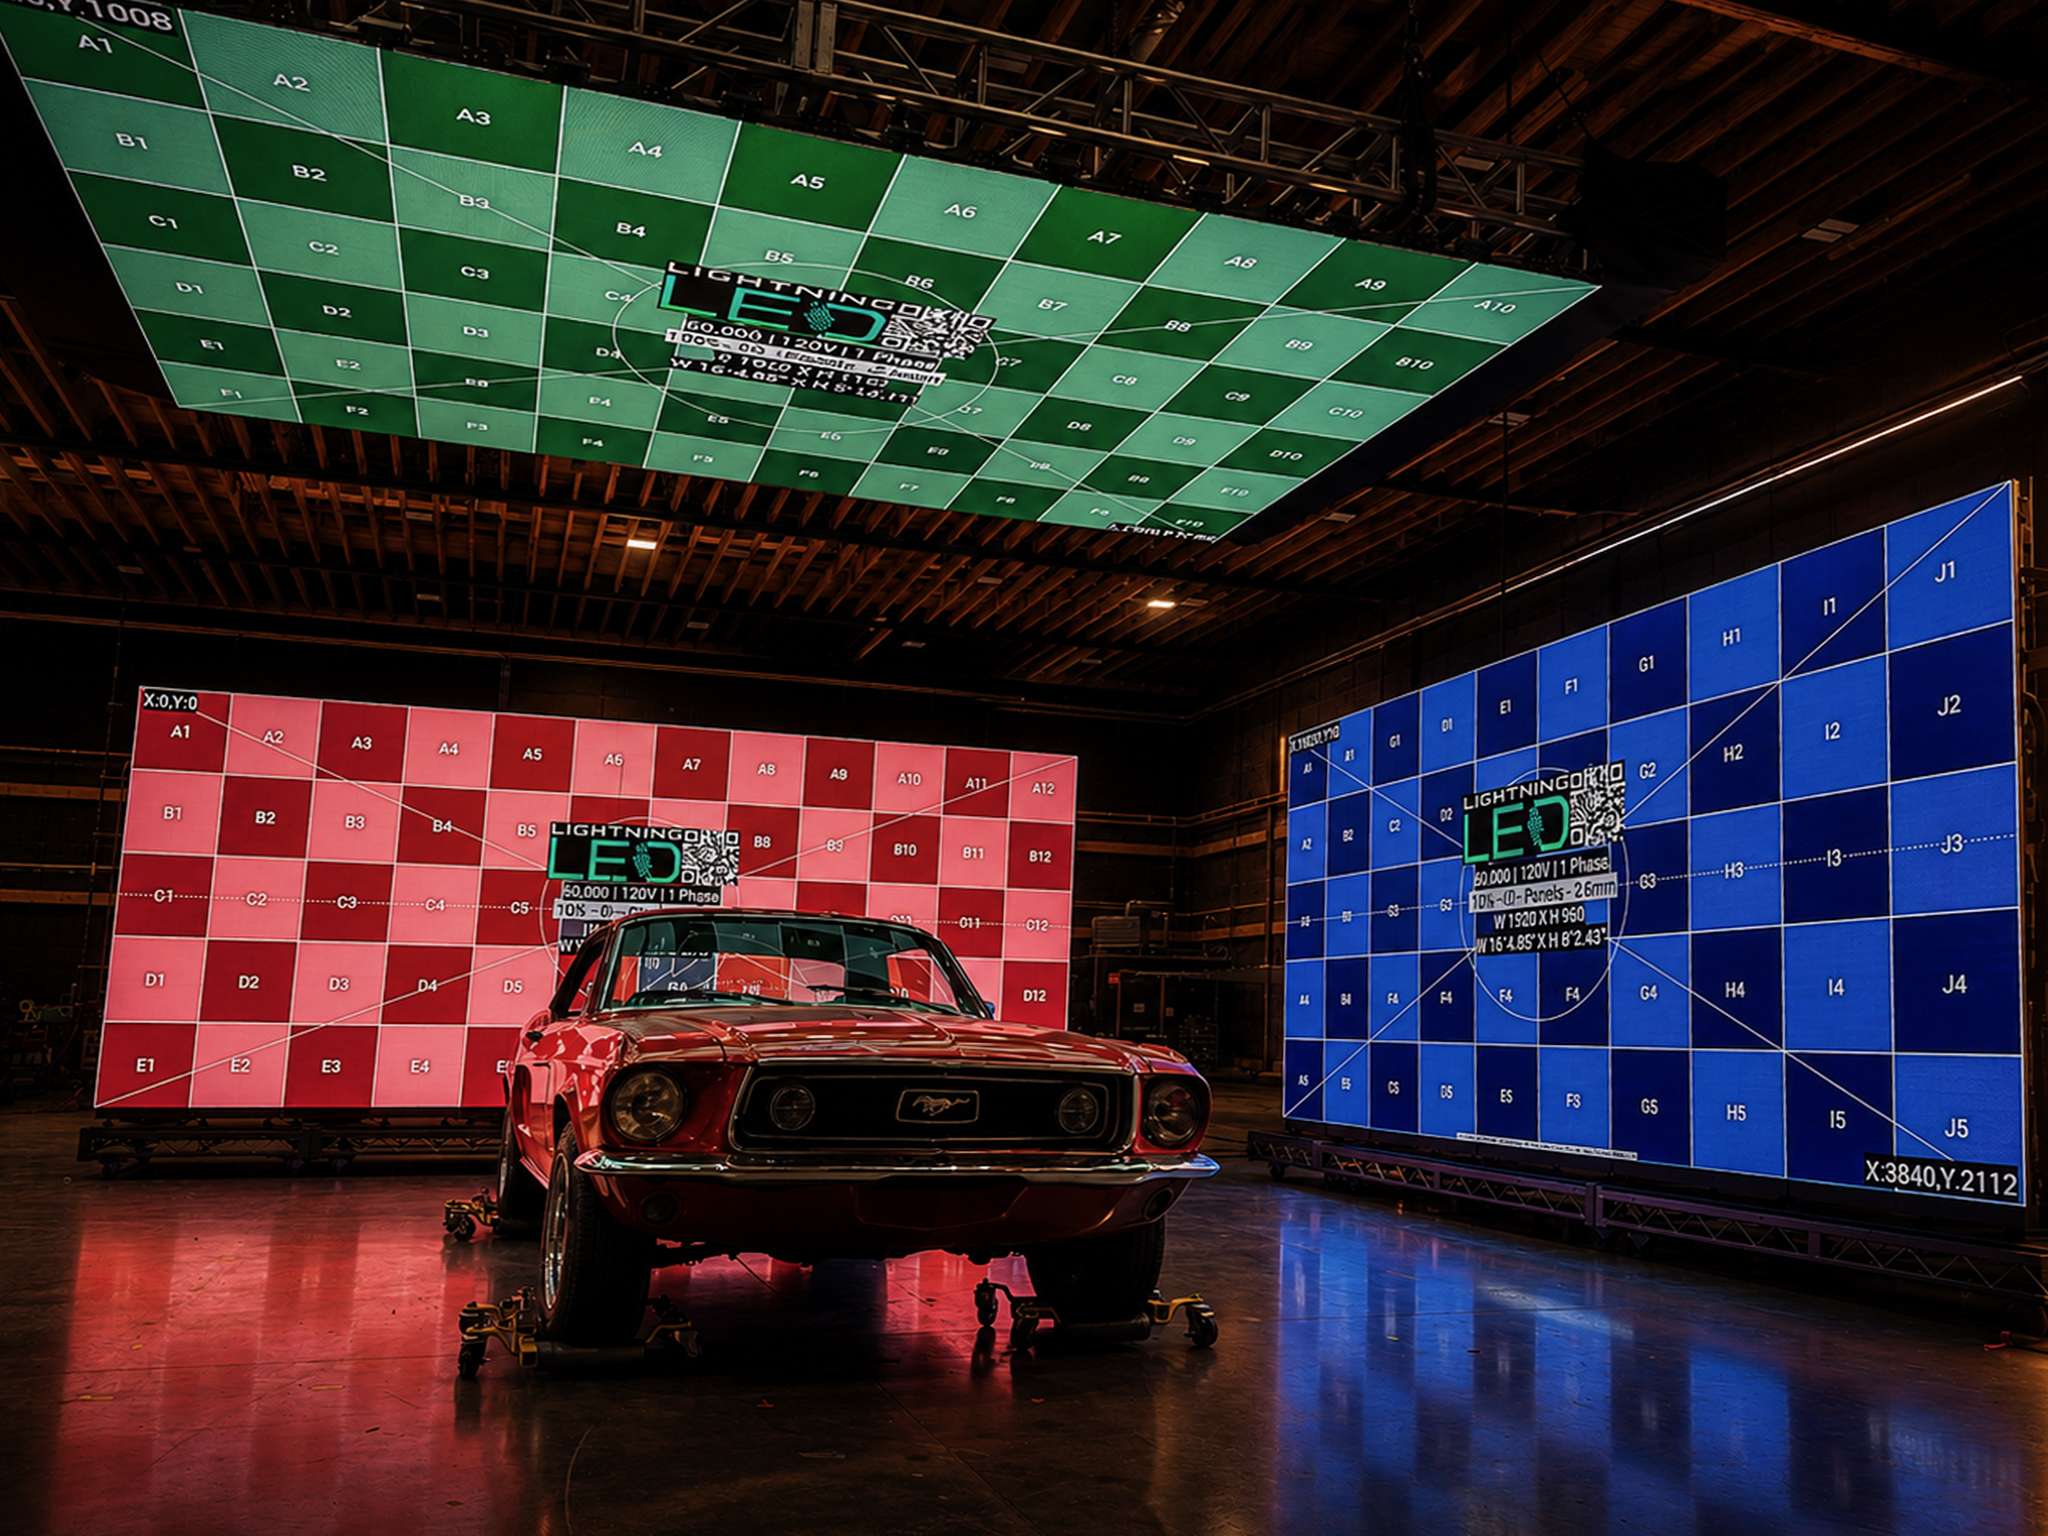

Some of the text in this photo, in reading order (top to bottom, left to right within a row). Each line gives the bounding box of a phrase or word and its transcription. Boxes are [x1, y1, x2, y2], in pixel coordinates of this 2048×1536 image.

[79, 34, 113, 54] A1
[273, 73, 310, 92] A2
[456, 108, 491, 126] A3
[115, 132, 148, 150] B1
[628, 141, 662, 158] A4
[292, 164, 327, 182] B2
[790, 173, 826, 190] A5
[459, 195, 490, 209] B3
[944, 203, 977, 218] A6
[148, 215, 178, 229] C1
[616, 222, 646, 238] B4
[1087, 230, 1122, 245] A7
[309, 241, 339, 256] C2
[764, 250, 795, 265] B5
[1224, 256, 1257, 269] A8
[460, 266, 489, 280] C3
[175, 282, 203, 294] D1
[667, 261, 896, 312] LIGHTNING
[905, 275, 935, 289] B6
[1355, 278, 1387, 291] A9
[604, 291, 632, 302] C4
[322, 304, 352, 318] D2
[659, 274, 887, 343] LED
[1037, 298, 1068, 311] B7
[1474, 298, 1516, 314] A10
[463, 326, 489, 338] D3
[783, 334, 837, 354] 120V
[1285, 339, 1313, 351] B9
[336, 359, 360, 370] E2
[1395, 356, 1434, 370] B10
[1224, 391, 1251, 402] C9
[1329, 407, 1363, 419] C10
[1269, 449, 1303, 461] D10
[1934, 560, 1955, 583] J1
[1823, 597, 1836, 616] I1
[1722, 627, 1741, 647] H1
[1638, 655, 1654, 673] G1
[1564, 678, 1578, 695] F1
[143, 692, 198, 710] X:0,Y:0
[1499, 699, 1512, 715] E1
[1937, 694, 1962, 717] J2
[170, 724, 190, 739] A1
[263, 731, 283, 744] A2
[1825, 721, 1841, 741] I2
[351, 736, 372, 750] A3
[438, 742, 459, 755] A4
[522, 747, 543, 761] A5
[604, 753, 623, 766] A6
[1723, 743, 1744, 763] H2
[682, 758, 701, 771] A7
[757, 763, 776, 776] A8
[1639, 761, 1657, 780] G2
[829, 768, 848, 781] A9
[897, 772, 921, 786] A10
[966, 776, 987, 789] A11
[1032, 782, 1055, 795] A12
[1463, 775, 1569, 811] LIGHTNING
[163, 806, 182, 820] B1
[255, 810, 276, 825] B2
[345, 815, 365, 829] B3
[432, 820, 452, 833] B4
[1388, 818, 1401, 833] C2
[1464, 795, 1570, 864] LED
[517, 823, 536, 838] B5
[551, 823, 683, 840] LIGHTNING
[754, 836, 771, 848] B8
[1941, 834, 1963, 854] J3
[893, 843, 917, 857] B10
[962, 846, 984, 859] B11
[1029, 849, 1052, 863] B12
[548, 837, 681, 884] LED
[1828, 849, 1842, 867] I3
[1521, 860, 1551, 880] 120V
[1560, 860, 1567, 876] 1
[1570, 856, 1608, 875] Phase
[1725, 862, 1743, 879] H3
[1639, 873, 1656, 889] G3
[154, 889, 173, 902] C1
[246, 892, 267, 906] C2
[622, 887, 658, 901] 120V
[668, 888, 675, 901] 1
[337, 895, 357, 909] C3
[425, 898, 445, 911] C4
[510, 901, 530, 915] C5
[1493, 914, 1507, 930] W
[1508, 911, 1537, 928] 1920
[1538, 909, 1548, 925] X
[1549, 907, 1560, 925] H
[1476, 938, 1488, 954] W
[1537, 932, 1547, 949] X
[1548, 932, 1559, 949] H
[145, 973, 165, 987] D1
[238, 975, 260, 990] D2
[329, 977, 349, 991] D3
[418, 980, 438, 992] D4
[1828, 978, 1845, 996] I4
[1942, 974, 1968, 994] J4
[1023, 989, 1047, 1002] D12
[1640, 984, 1658, 1001] G4
[1725, 981, 1746, 998] H4
[137, 1059, 154, 1072] E1
[231, 1059, 250, 1072] E2
[321, 1059, 342, 1074] E3
[410, 1059, 430, 1073] E4
[1726, 1104, 1747, 1122] H5
[1830, 1110, 1847, 1130] I5
[1944, 1118, 1969, 1139] J5
[1865, 1159, 2018, 1197] X:3840,Y.2112
